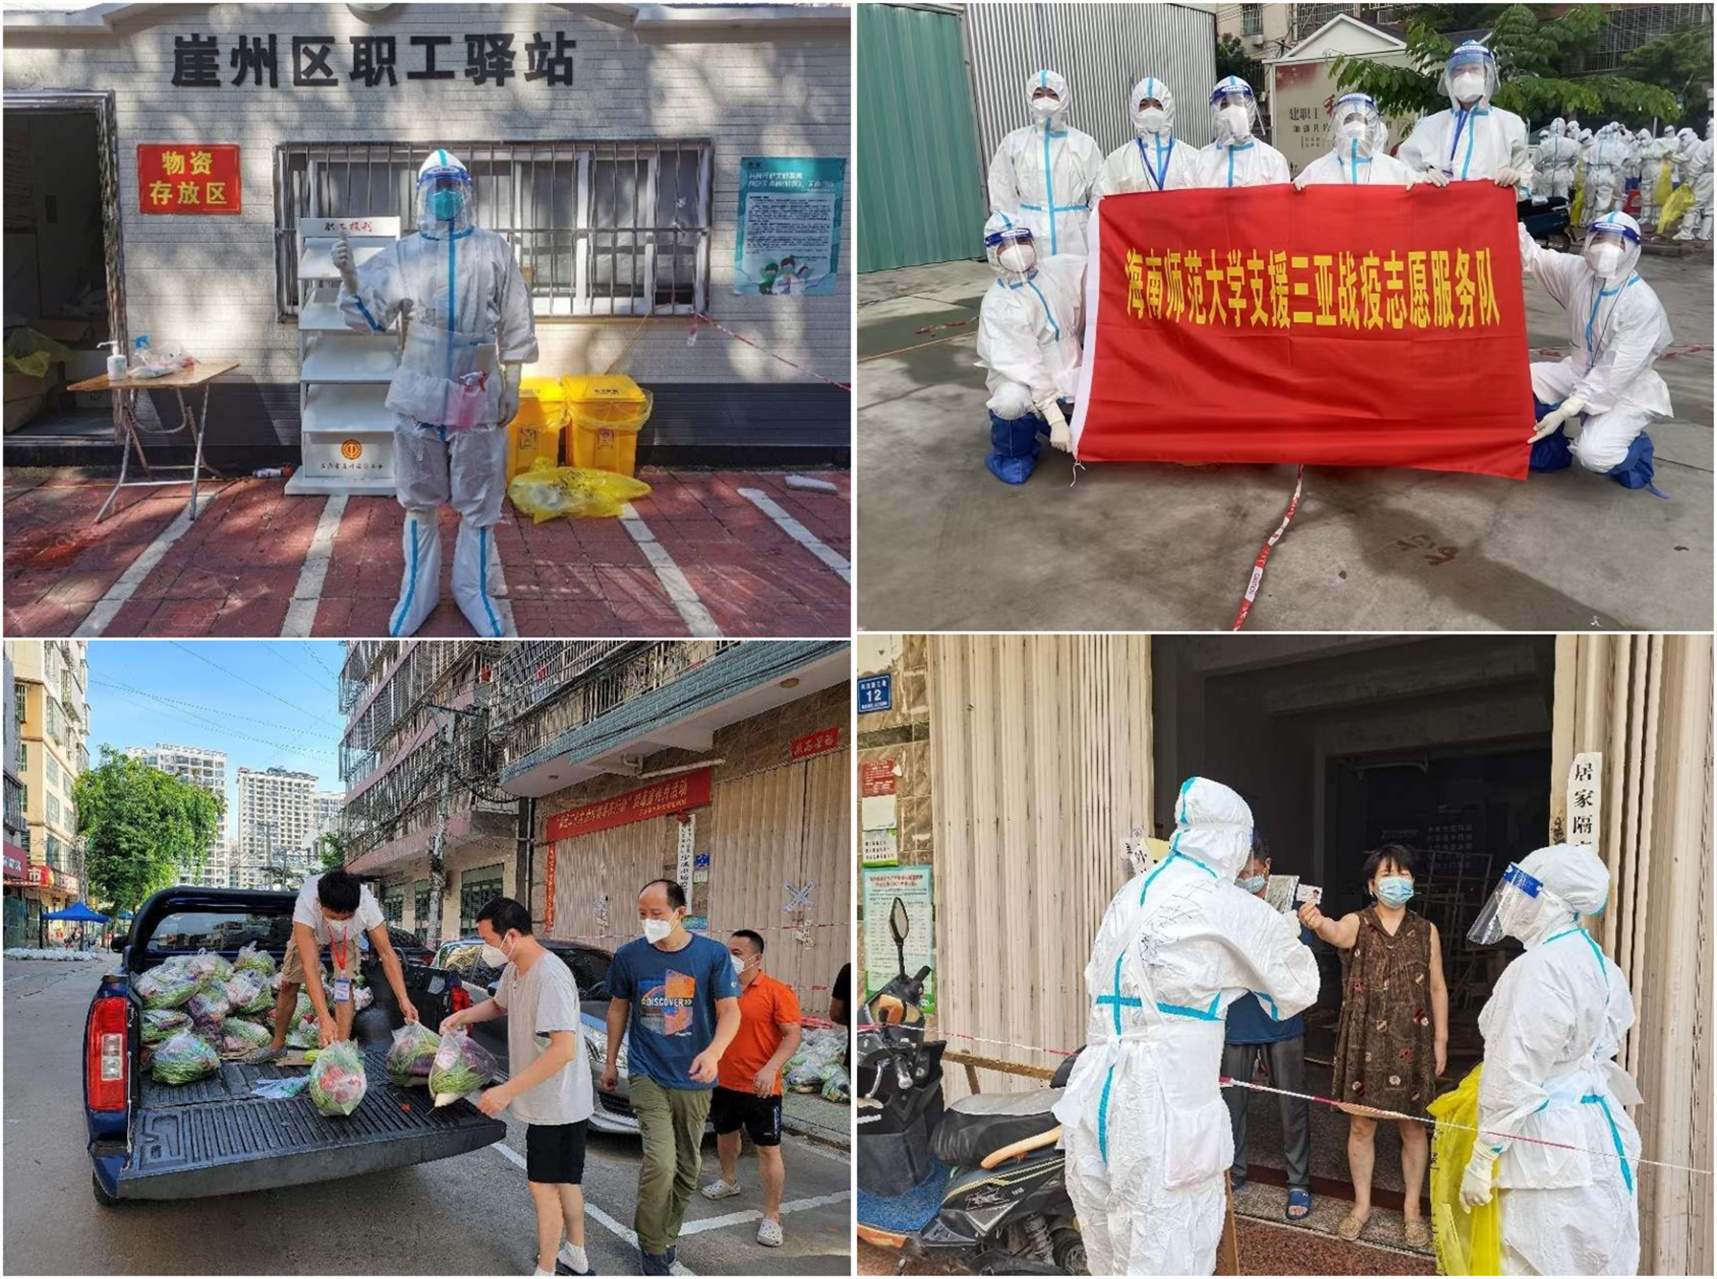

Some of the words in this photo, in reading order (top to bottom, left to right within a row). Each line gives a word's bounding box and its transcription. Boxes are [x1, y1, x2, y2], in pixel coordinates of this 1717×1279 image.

[171, 32, 576, 89] 崖州区职工驿站
[161, 150, 214, 176] 物资
[149, 181, 228, 206] 存放区
[1124, 247, 1501, 330] 海南师范大学支援三亚战疫志愿服务队
[866, 689, 882, 702] 12
[1572, 762, 1594, 847] 居家隔
[646, 997, 684, 1007] DISCOVER
